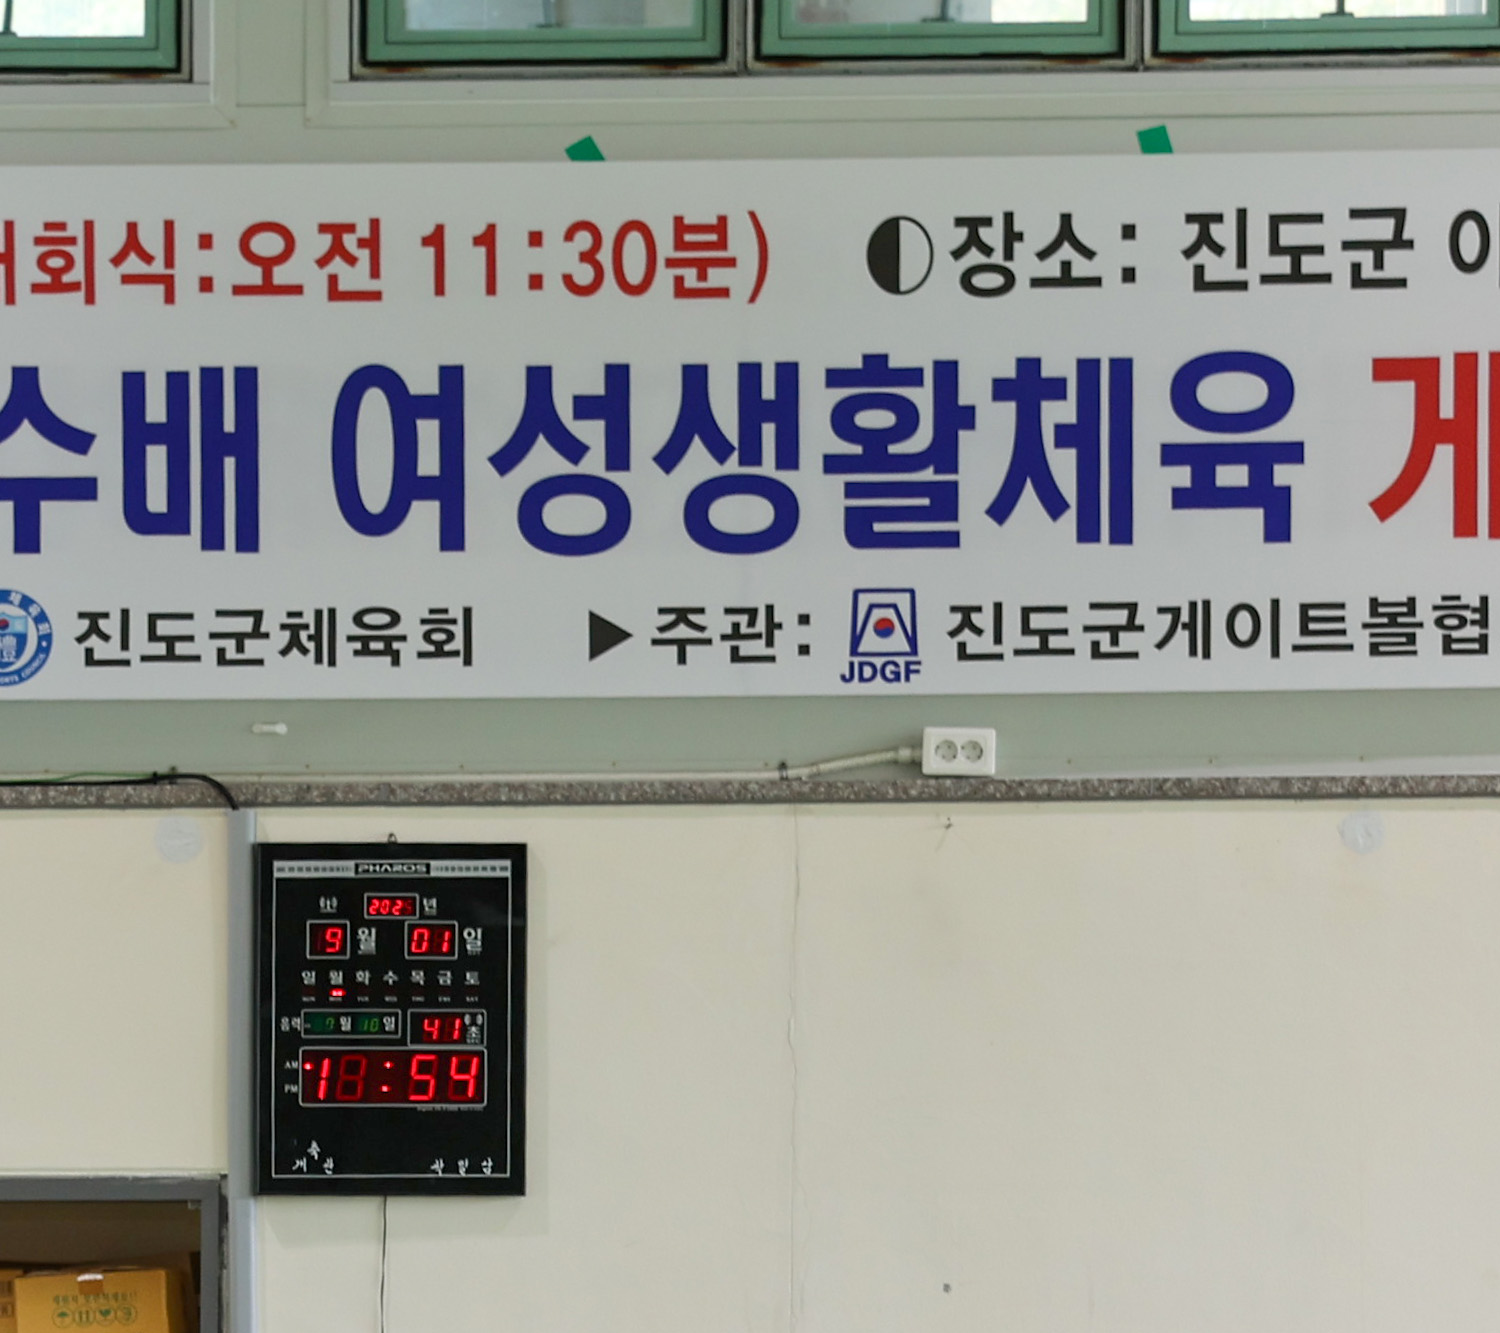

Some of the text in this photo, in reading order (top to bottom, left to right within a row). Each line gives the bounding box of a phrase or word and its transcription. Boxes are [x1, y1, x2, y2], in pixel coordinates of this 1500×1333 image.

[946, 210, 1137, 298] 장소:
[1181, 207, 1415, 293] 진도군
[330, 349, 1305, 557] 여성생활체육
[74, 606, 474, 669] 진도군체육회
[650, 603, 812, 667] 주관:
[840, 659, 922, 684] JDGF
[358, 863, 428, 875] PHAROS
[325, 926, 343, 953] 9
[463, 927, 483, 949] 일
[382, 969, 399, 986] 수
[436, 969, 453, 986] 금
[464, 969, 480, 986] 토
[422, 1017, 462, 1041] 41
[285, 1084, 299, 1094] PM
